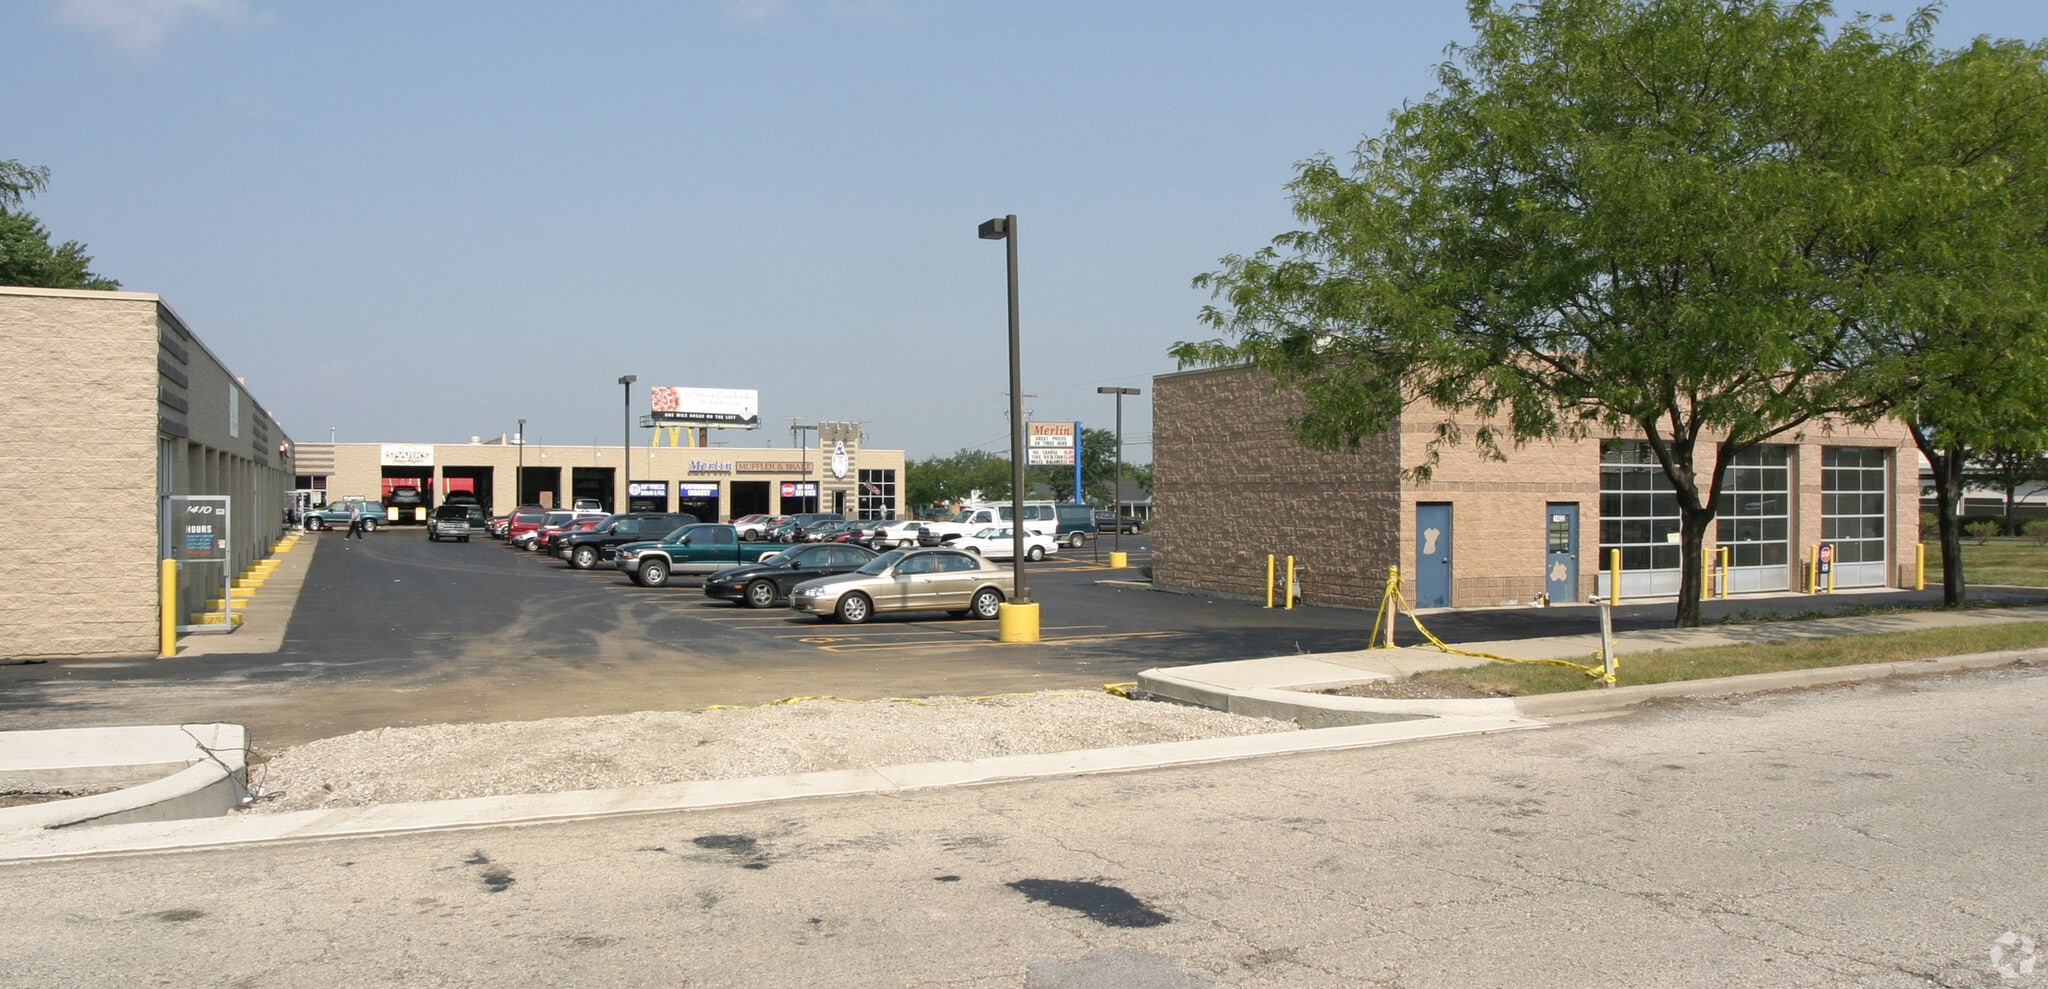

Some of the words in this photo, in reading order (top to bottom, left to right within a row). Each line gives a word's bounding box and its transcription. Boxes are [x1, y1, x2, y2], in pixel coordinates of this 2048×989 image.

[1033, 425, 1070, 436] Merlin
[385, 451, 430, 459] SPARKS
[689, 460, 732, 471] Merlin
[185, 505, 213, 514] 1410
[185, 525, 212, 534] HOURS
